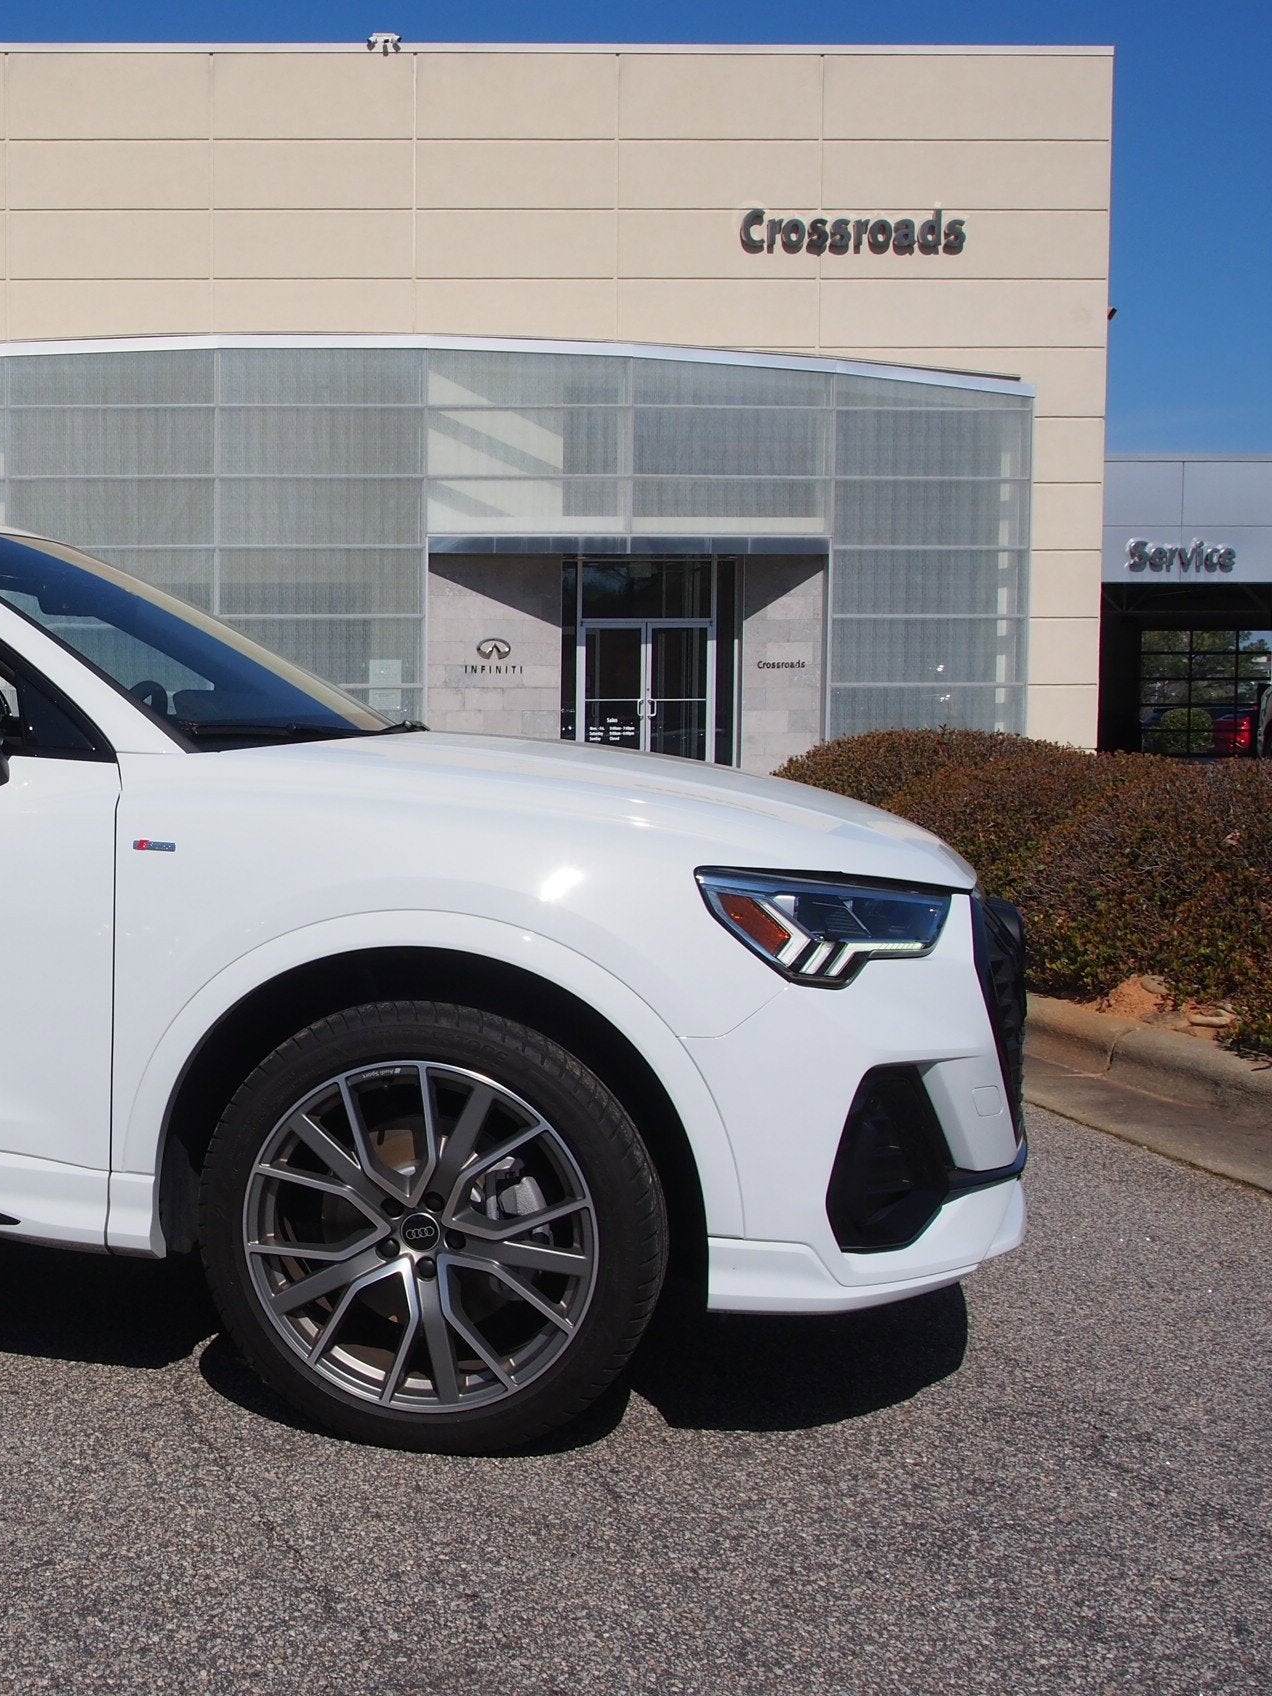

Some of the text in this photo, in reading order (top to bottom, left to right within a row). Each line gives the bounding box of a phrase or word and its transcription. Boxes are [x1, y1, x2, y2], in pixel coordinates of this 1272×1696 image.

[740, 208, 967, 254] Crossroads
[1128, 540, 1236, 572] Service
[464, 665, 523, 674] INFINITI
[757, 660, 806, 669] Crossroads
